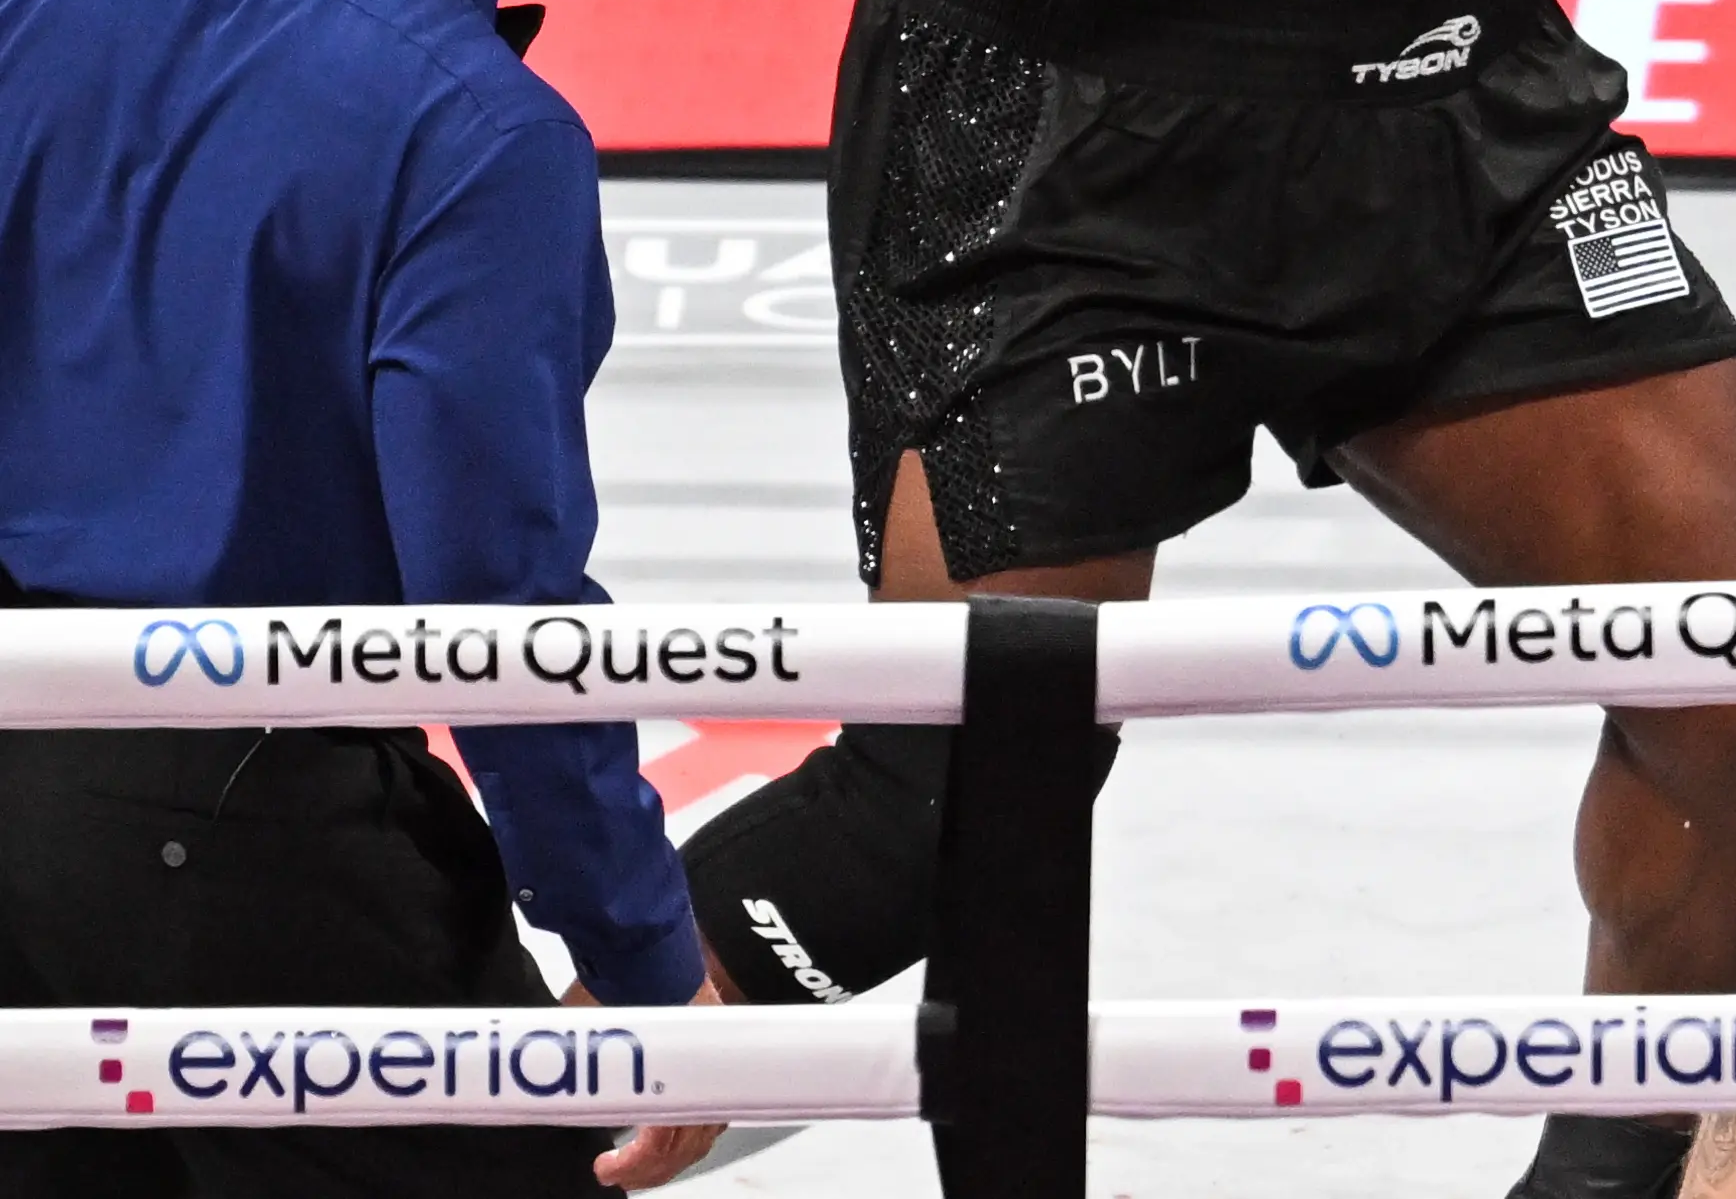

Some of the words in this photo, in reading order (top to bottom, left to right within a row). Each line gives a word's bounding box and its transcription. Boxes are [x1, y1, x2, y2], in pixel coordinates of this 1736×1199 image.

[1351, 46, 1471, 83] TYSON
[1550, 174, 1653, 220] SIERRA
[1555, 198, 1661, 240] TYSON
[1067, 336, 1202, 405] BYLT
[267, 618, 500, 686] Meta
[522, 616, 801, 694] Quest
[1421, 598, 1655, 666] Meta
[169, 1019, 645, 1112] experian
